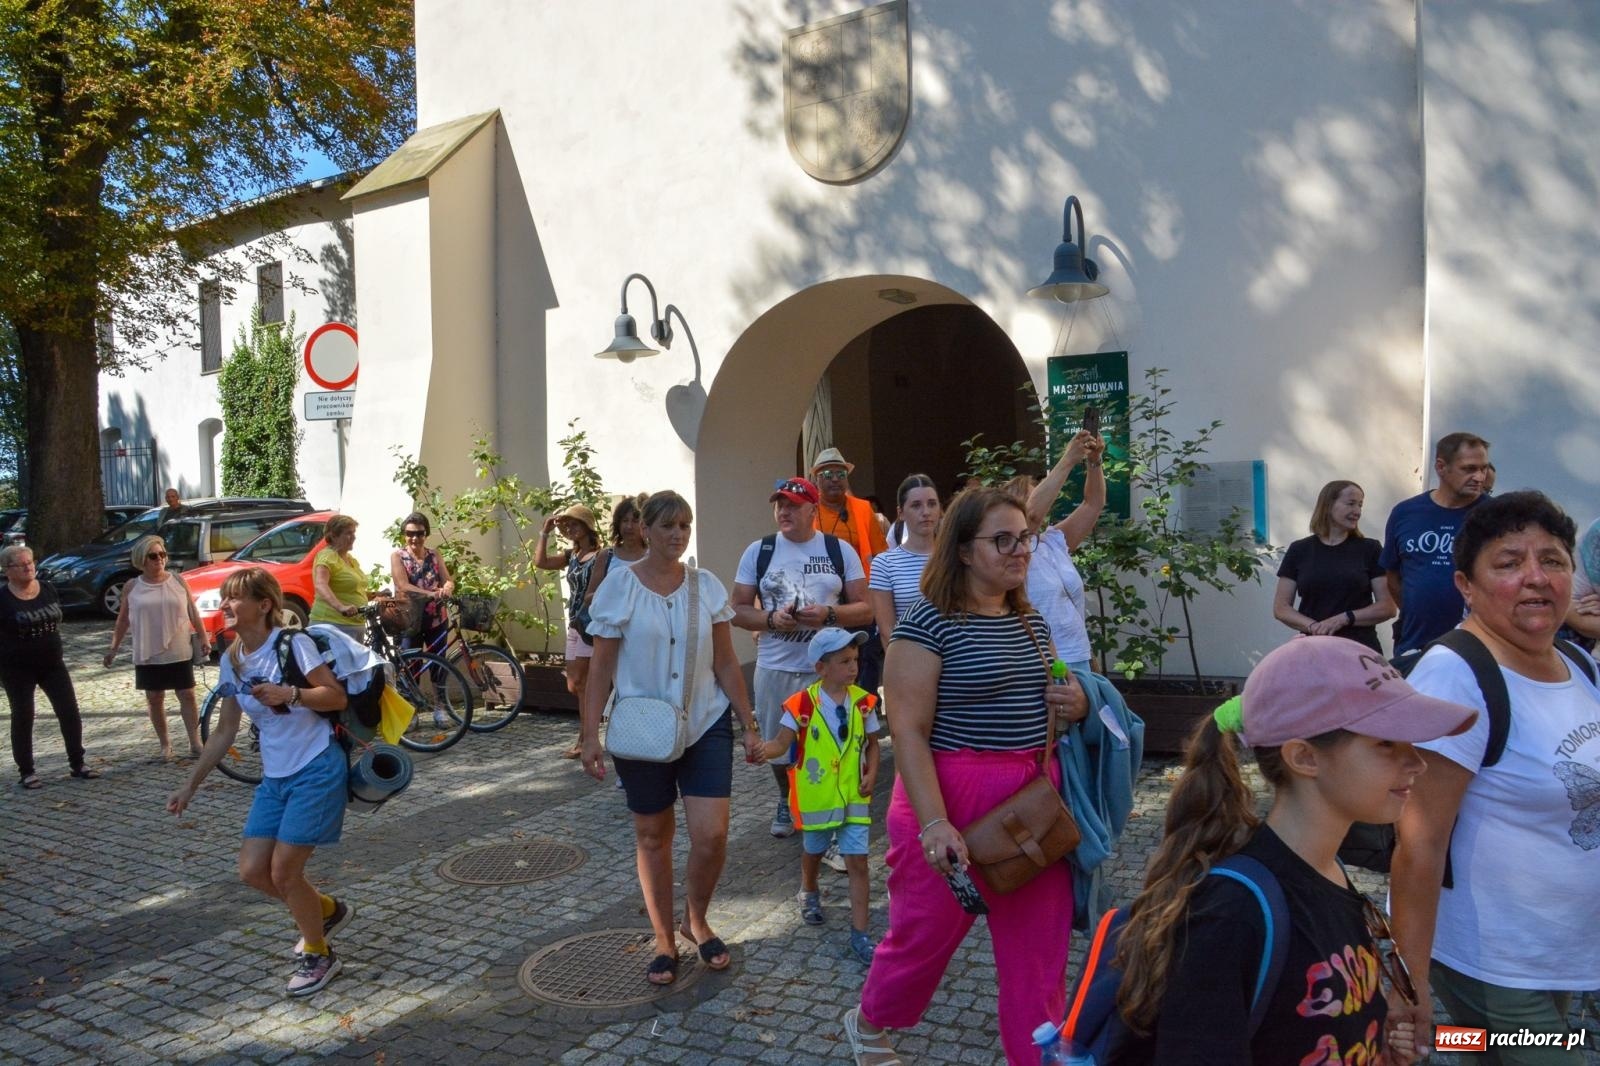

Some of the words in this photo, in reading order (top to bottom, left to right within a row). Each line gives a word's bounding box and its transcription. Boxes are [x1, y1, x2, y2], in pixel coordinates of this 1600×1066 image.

[1052, 381, 1124, 395] MASZYNOWNIA
[809, 556, 831, 564] RUDE
[803, 563, 837, 575] DOGS
